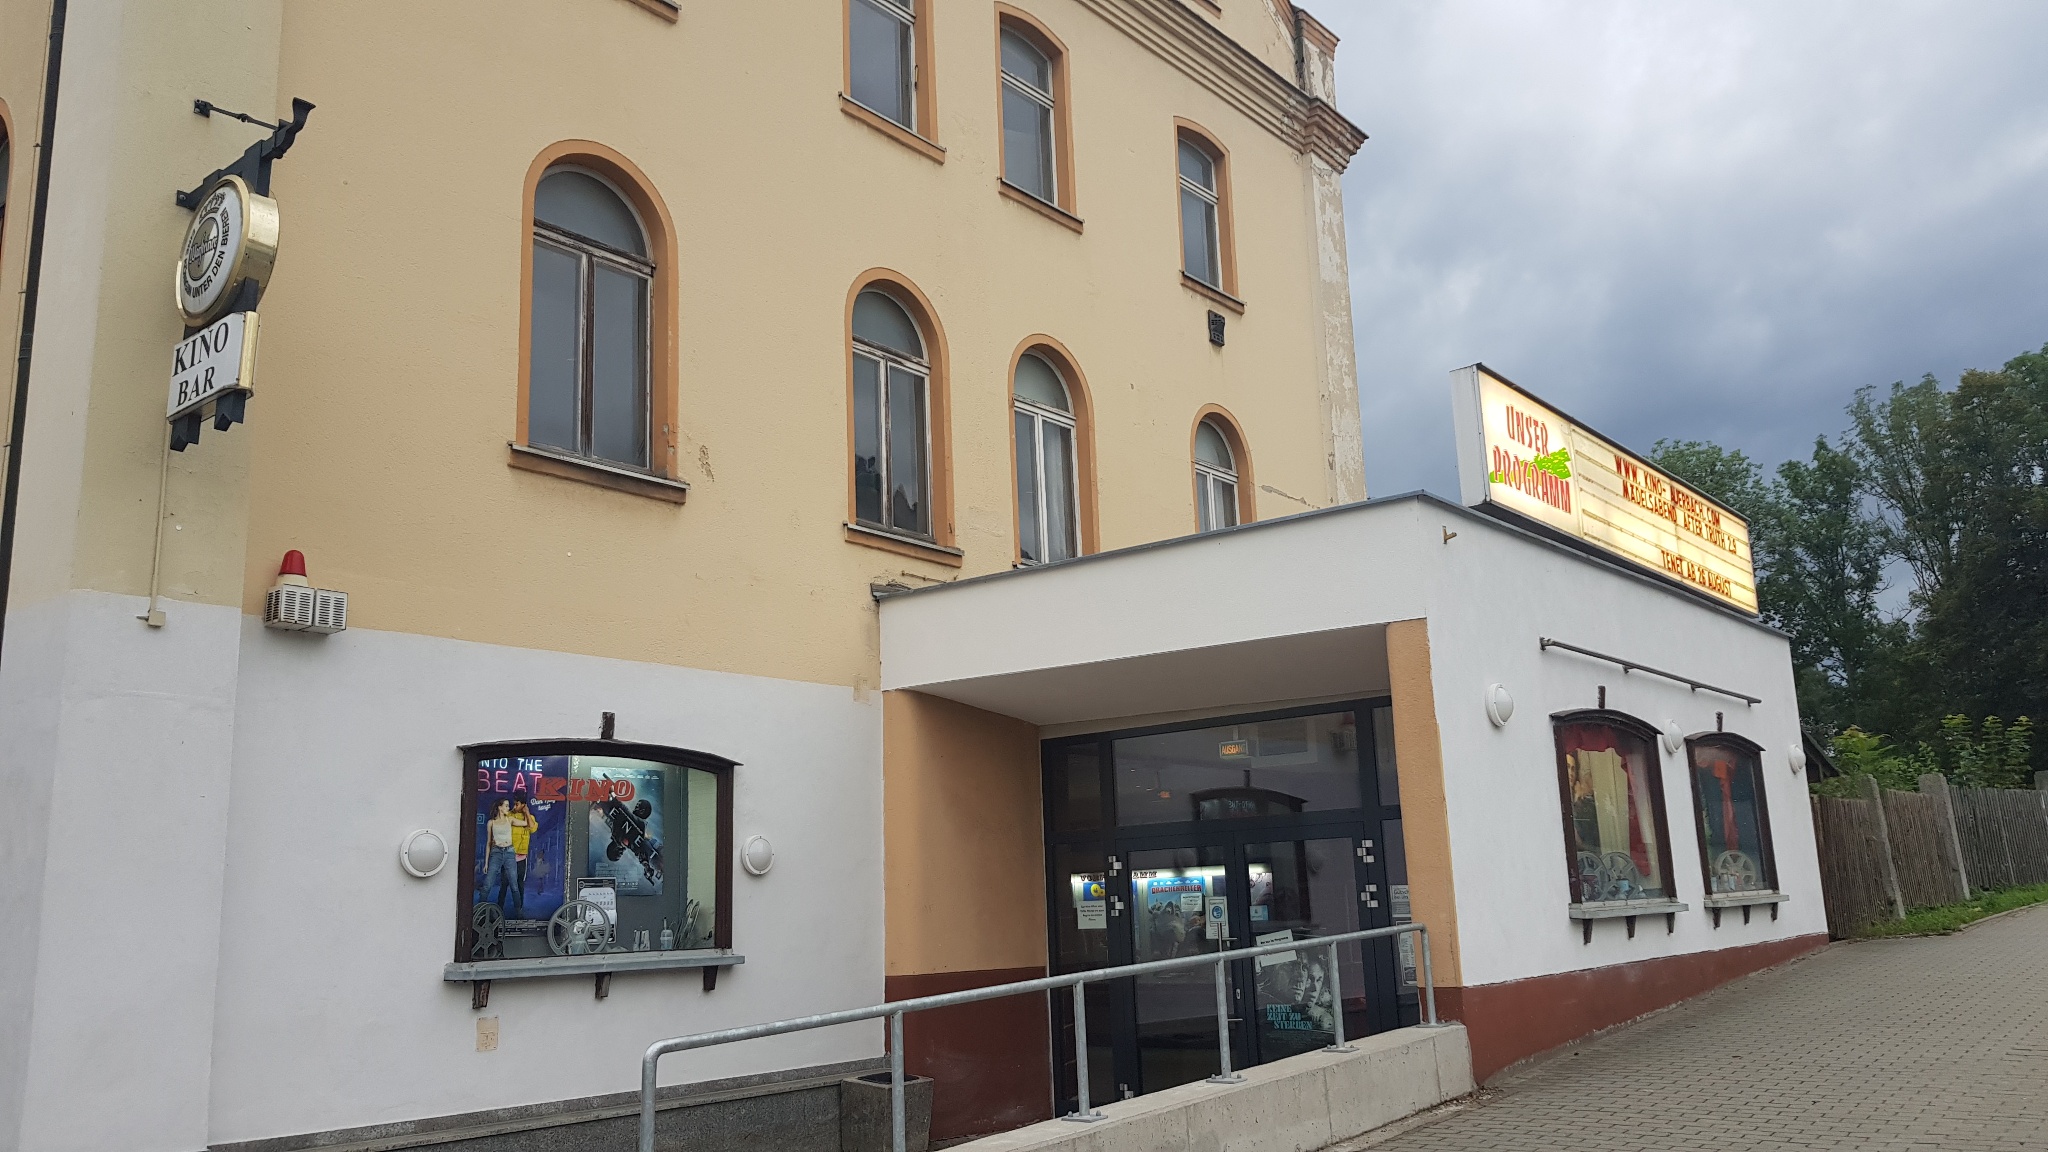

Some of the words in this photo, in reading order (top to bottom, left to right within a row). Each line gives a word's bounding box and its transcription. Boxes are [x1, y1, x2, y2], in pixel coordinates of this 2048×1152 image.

[192, 275, 213, 298] UNTER
[213, 251, 225, 277] DEN
[172, 321, 229, 378] KINO
[176, 365, 216, 408] BAR
[1505, 404, 1551, 457] UNSER
[1492, 445, 1571, 515] PROGRAMM
[1684, 512, 1703, 538] AFTER
[1705, 524, 1726, 550] TRUTH
[1661, 550, 1683, 575] TENET
[1687, 562, 1696, 582] AB
[1697, 567, 1706, 587] 26
[1708, 572, 1732, 599] AUGUST
[478, 769, 543, 794] BEAT
[480, 757, 508, 769] NTO
[518, 757, 543, 772] THE
[535, 776, 636, 802] KINO
[1266, 1003, 1292, 1013] KEINE
[1266, 1012, 1288, 1021] ZEIT
[1289, 1012, 1302, 1021] ZU
[1273, 1020, 1313, 1030] STERBEN
